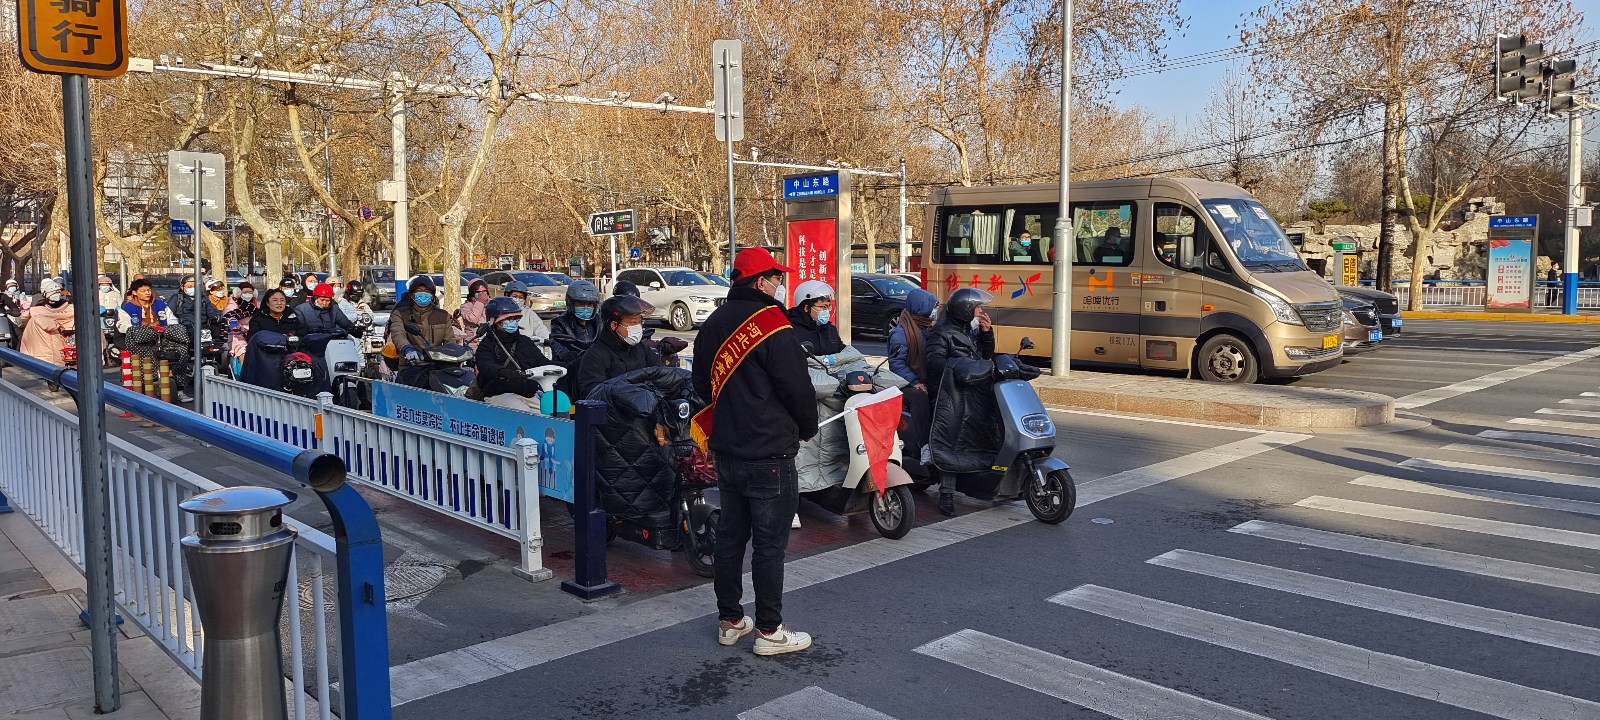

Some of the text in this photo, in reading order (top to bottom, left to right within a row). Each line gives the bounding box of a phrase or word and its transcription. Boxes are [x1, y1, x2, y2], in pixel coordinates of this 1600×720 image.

[793, 176, 830, 189] 中山东路
[798, 234, 807, 280] 科技是第
[809, 242, 817, 280] 人才是
[396, 404, 505, 447] 多走几步莫跨栏 不让生命留遗憾
